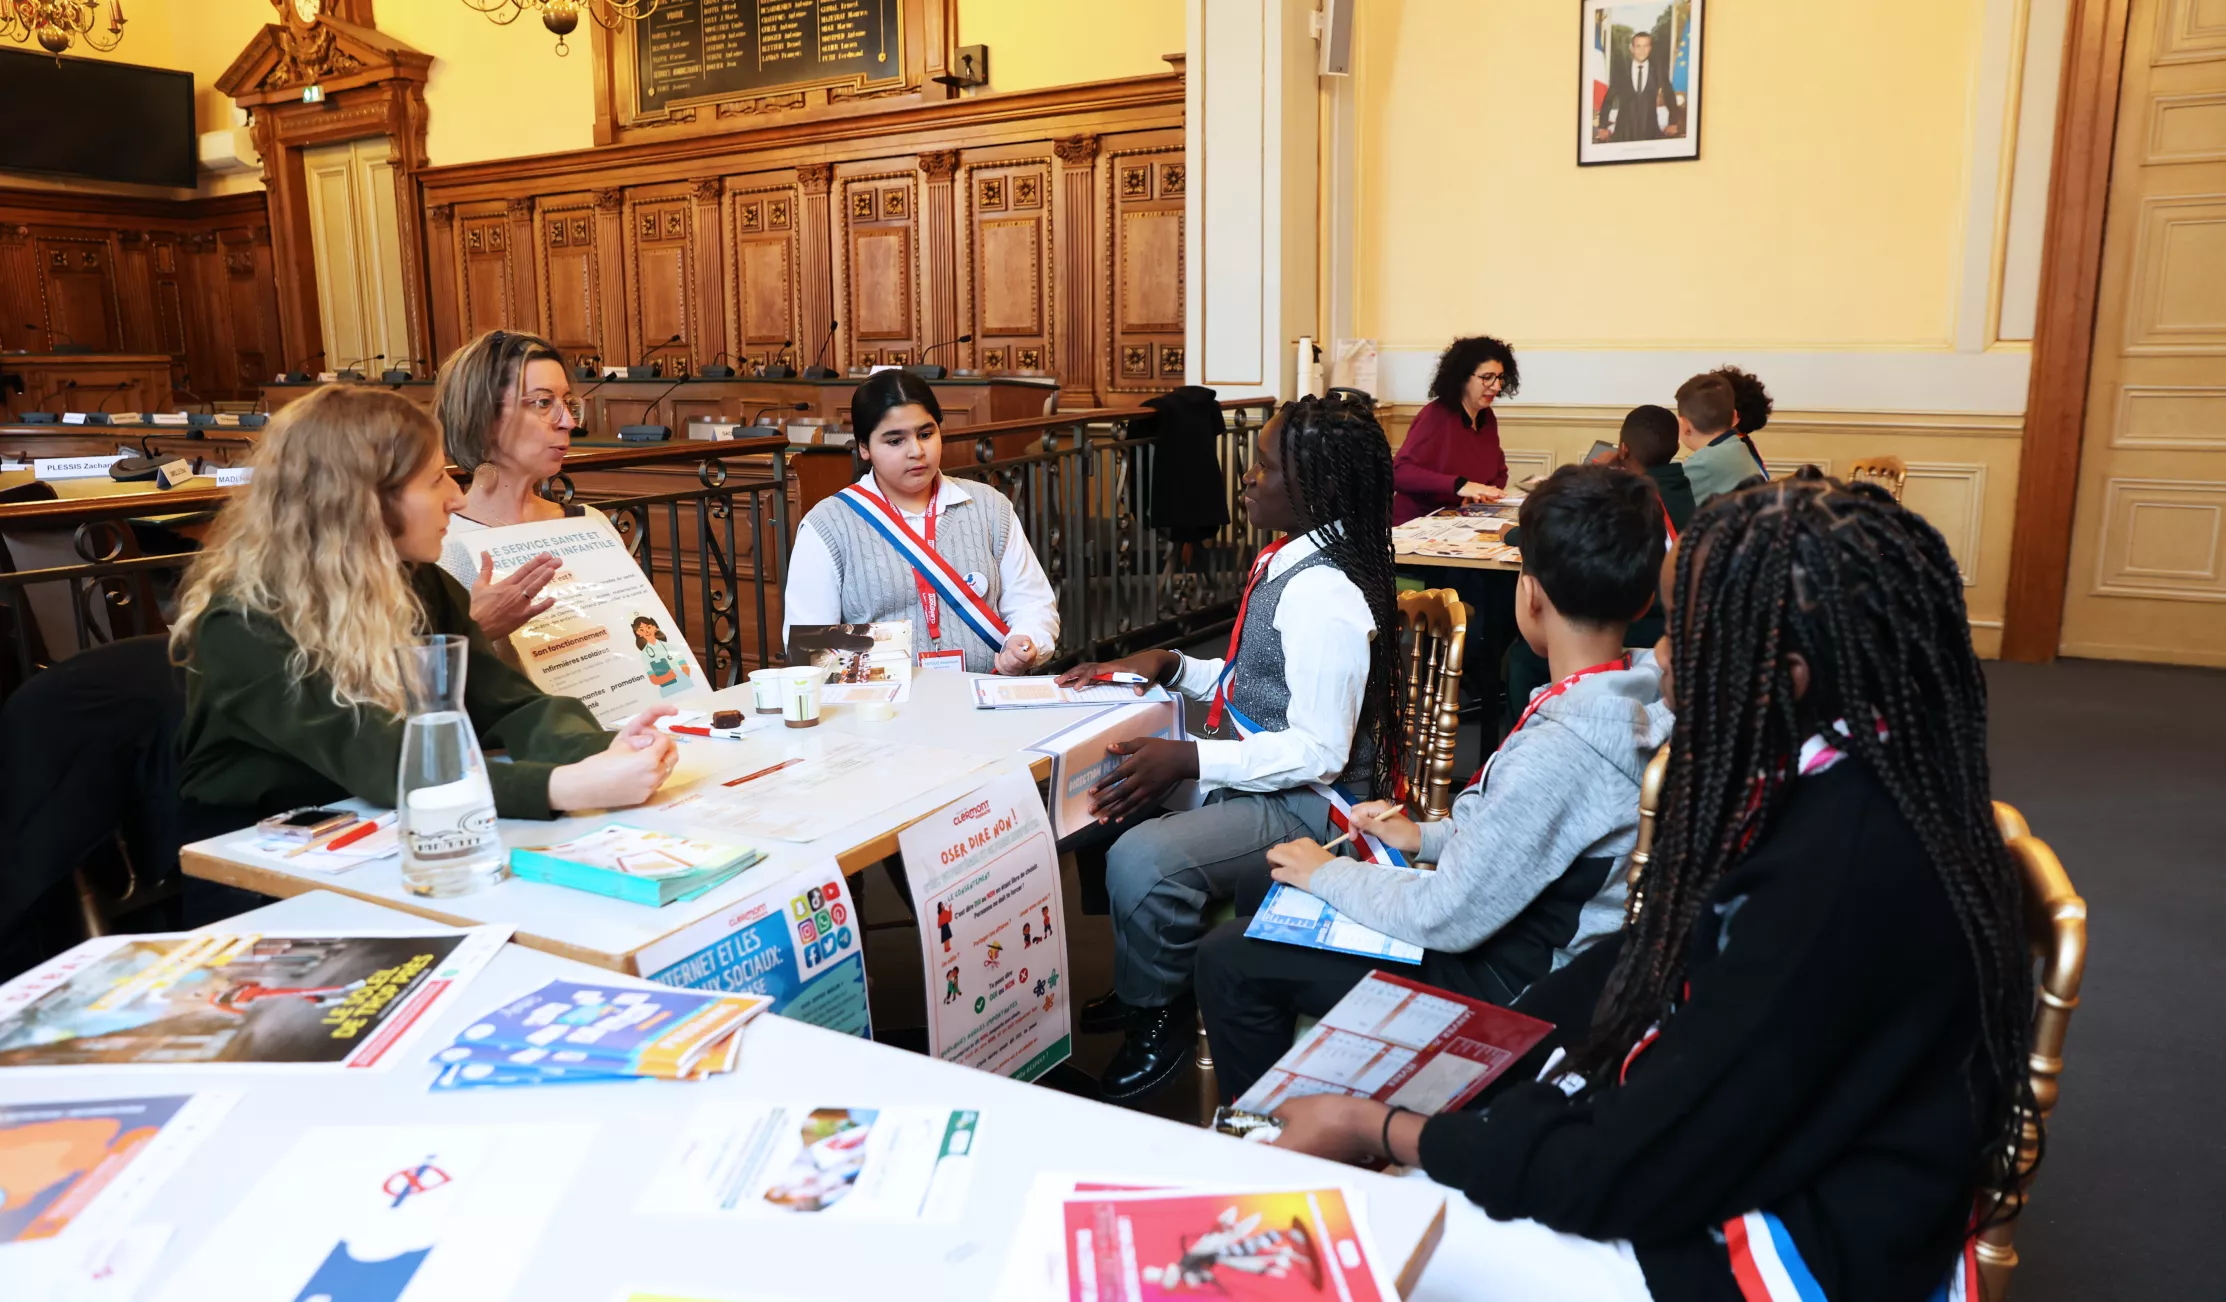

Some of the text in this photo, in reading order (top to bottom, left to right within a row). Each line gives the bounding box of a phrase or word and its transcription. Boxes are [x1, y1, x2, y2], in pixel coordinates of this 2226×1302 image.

[47, 462, 82, 471] PLESSIS
[501, 538, 551, 555] SERVICE
[551, 531, 587, 546] SANTÉ
[588, 531, 600, 541] ET
[561, 540, 616, 556] INFANTILE
[532, 629, 607, 658] Son fonctionnement
[542, 656, 580, 674] Infirmières
[610, 674, 645, 692] promotion
[953, 800, 990, 826] CLERMONT
[941, 843, 968, 865] OSER
[968, 827, 991, 849] DIRE
[994, 816, 1012, 838] NON
[986, 889, 996, 900] NON
[716, 940, 735, 967] ET
[735, 927, 762, 957] LES
[1004, 978, 1015, 990] NON
[330, 1018, 369, 1039] DE
[353, 983, 399, 1017] TROP
